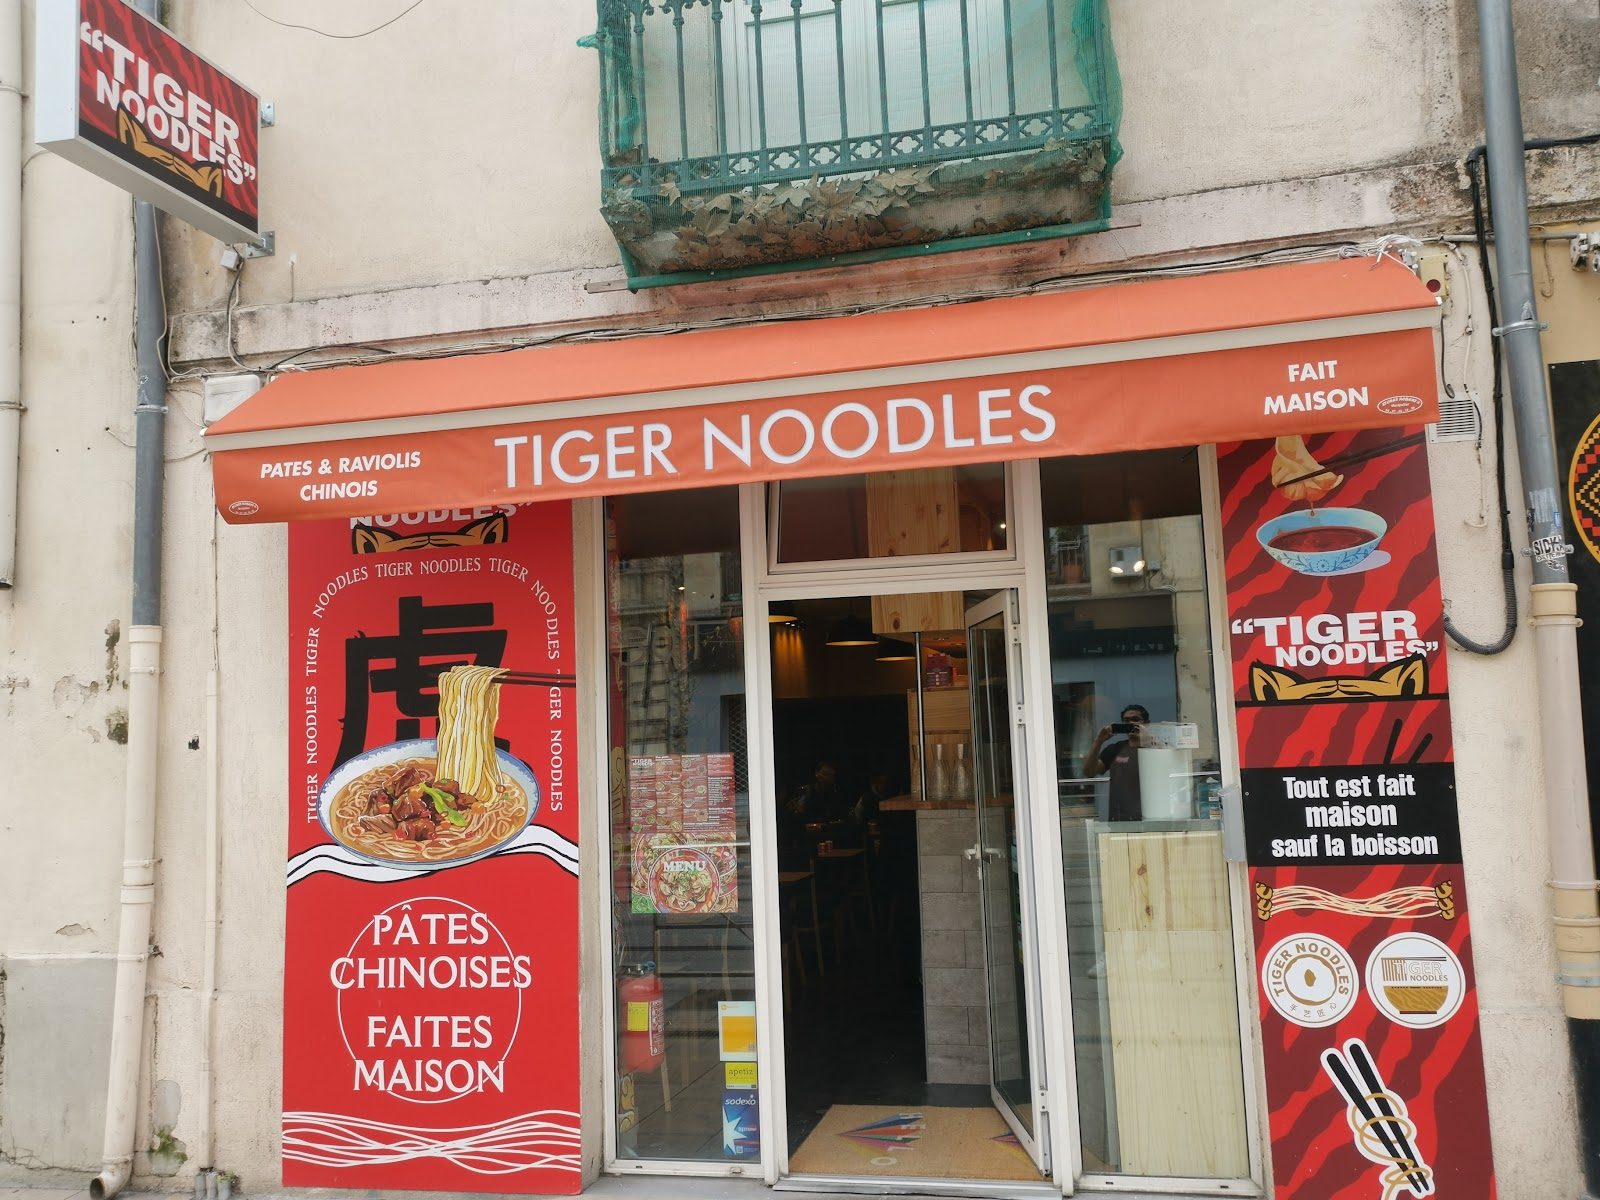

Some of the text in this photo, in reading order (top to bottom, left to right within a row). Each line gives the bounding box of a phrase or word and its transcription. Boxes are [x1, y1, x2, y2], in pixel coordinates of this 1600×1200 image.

[1288, 360, 1338, 382] FAIT
[1264, 387, 1369, 415] MAISON
[494, 384, 1056, 489] TIGER NOODLES
[260, 451, 421, 479] PATES & RAVIOLIS
[300, 480, 378, 502] CHINOIS
[305, 557, 563, 823] TIGER NOODLES TIGER NOODLES TIGER NOODLES TIGER NOODLES GER NOODLES
[1283, 774, 1416, 799] Tout est fait
[1305, 801, 1397, 828] maison
[1271, 833, 1439, 858] sauf la boisson
[663, 860, 707, 872] MENU
[372, 904, 489, 945] PÂTES
[330, 955, 532, 990] CHINOISES
[1272, 942, 1350, 997] TIGER NOODLES
[1410, 974, 1449, 982] NOODLES
[367, 1015, 493, 1049] FAITES
[353, 1059, 504, 1093] MAISON
[728, 1067, 754, 1076] apetiz
[725, 1096, 756, 1106] sodexo
